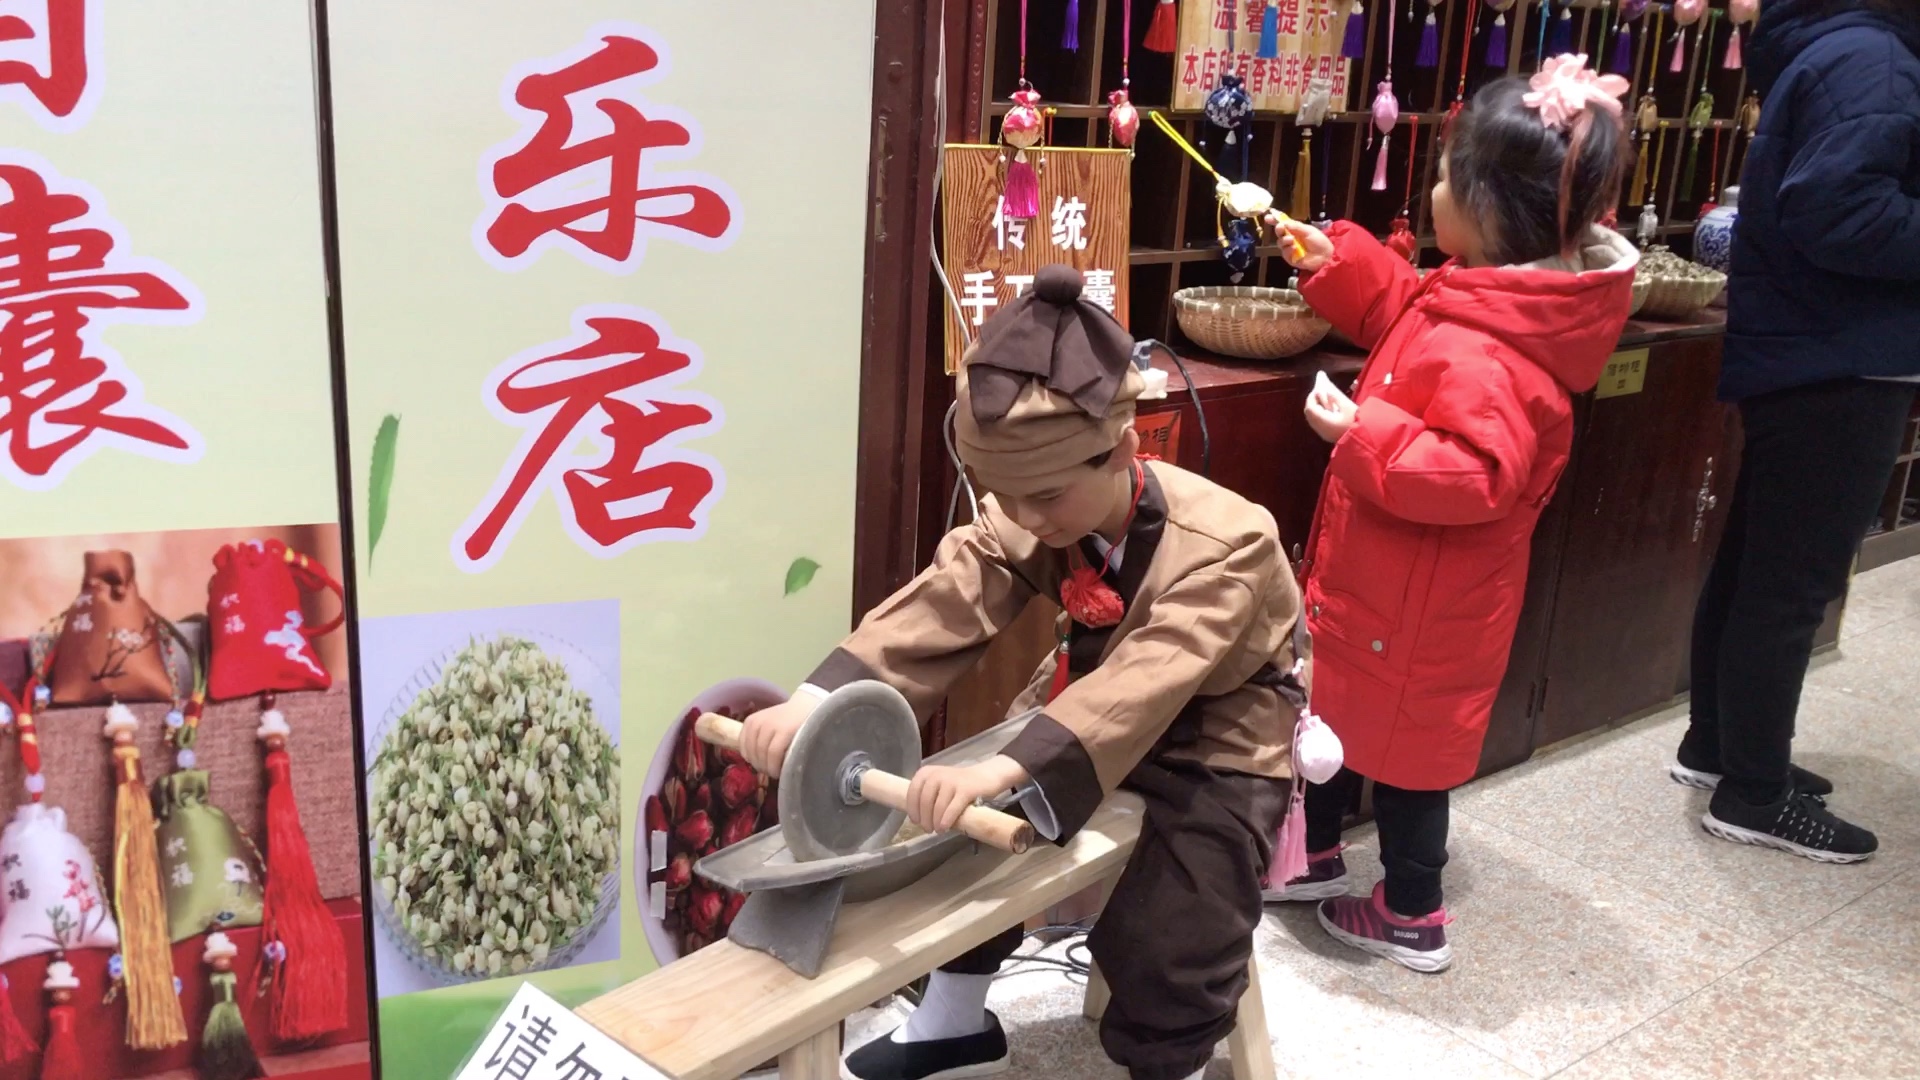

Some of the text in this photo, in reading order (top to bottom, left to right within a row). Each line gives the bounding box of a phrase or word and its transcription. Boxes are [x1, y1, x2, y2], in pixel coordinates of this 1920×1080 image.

[992, 195, 1087, 250] 传统
[465, 35, 731, 561] 乐店
[961, 269, 1116, 326] 手囊
